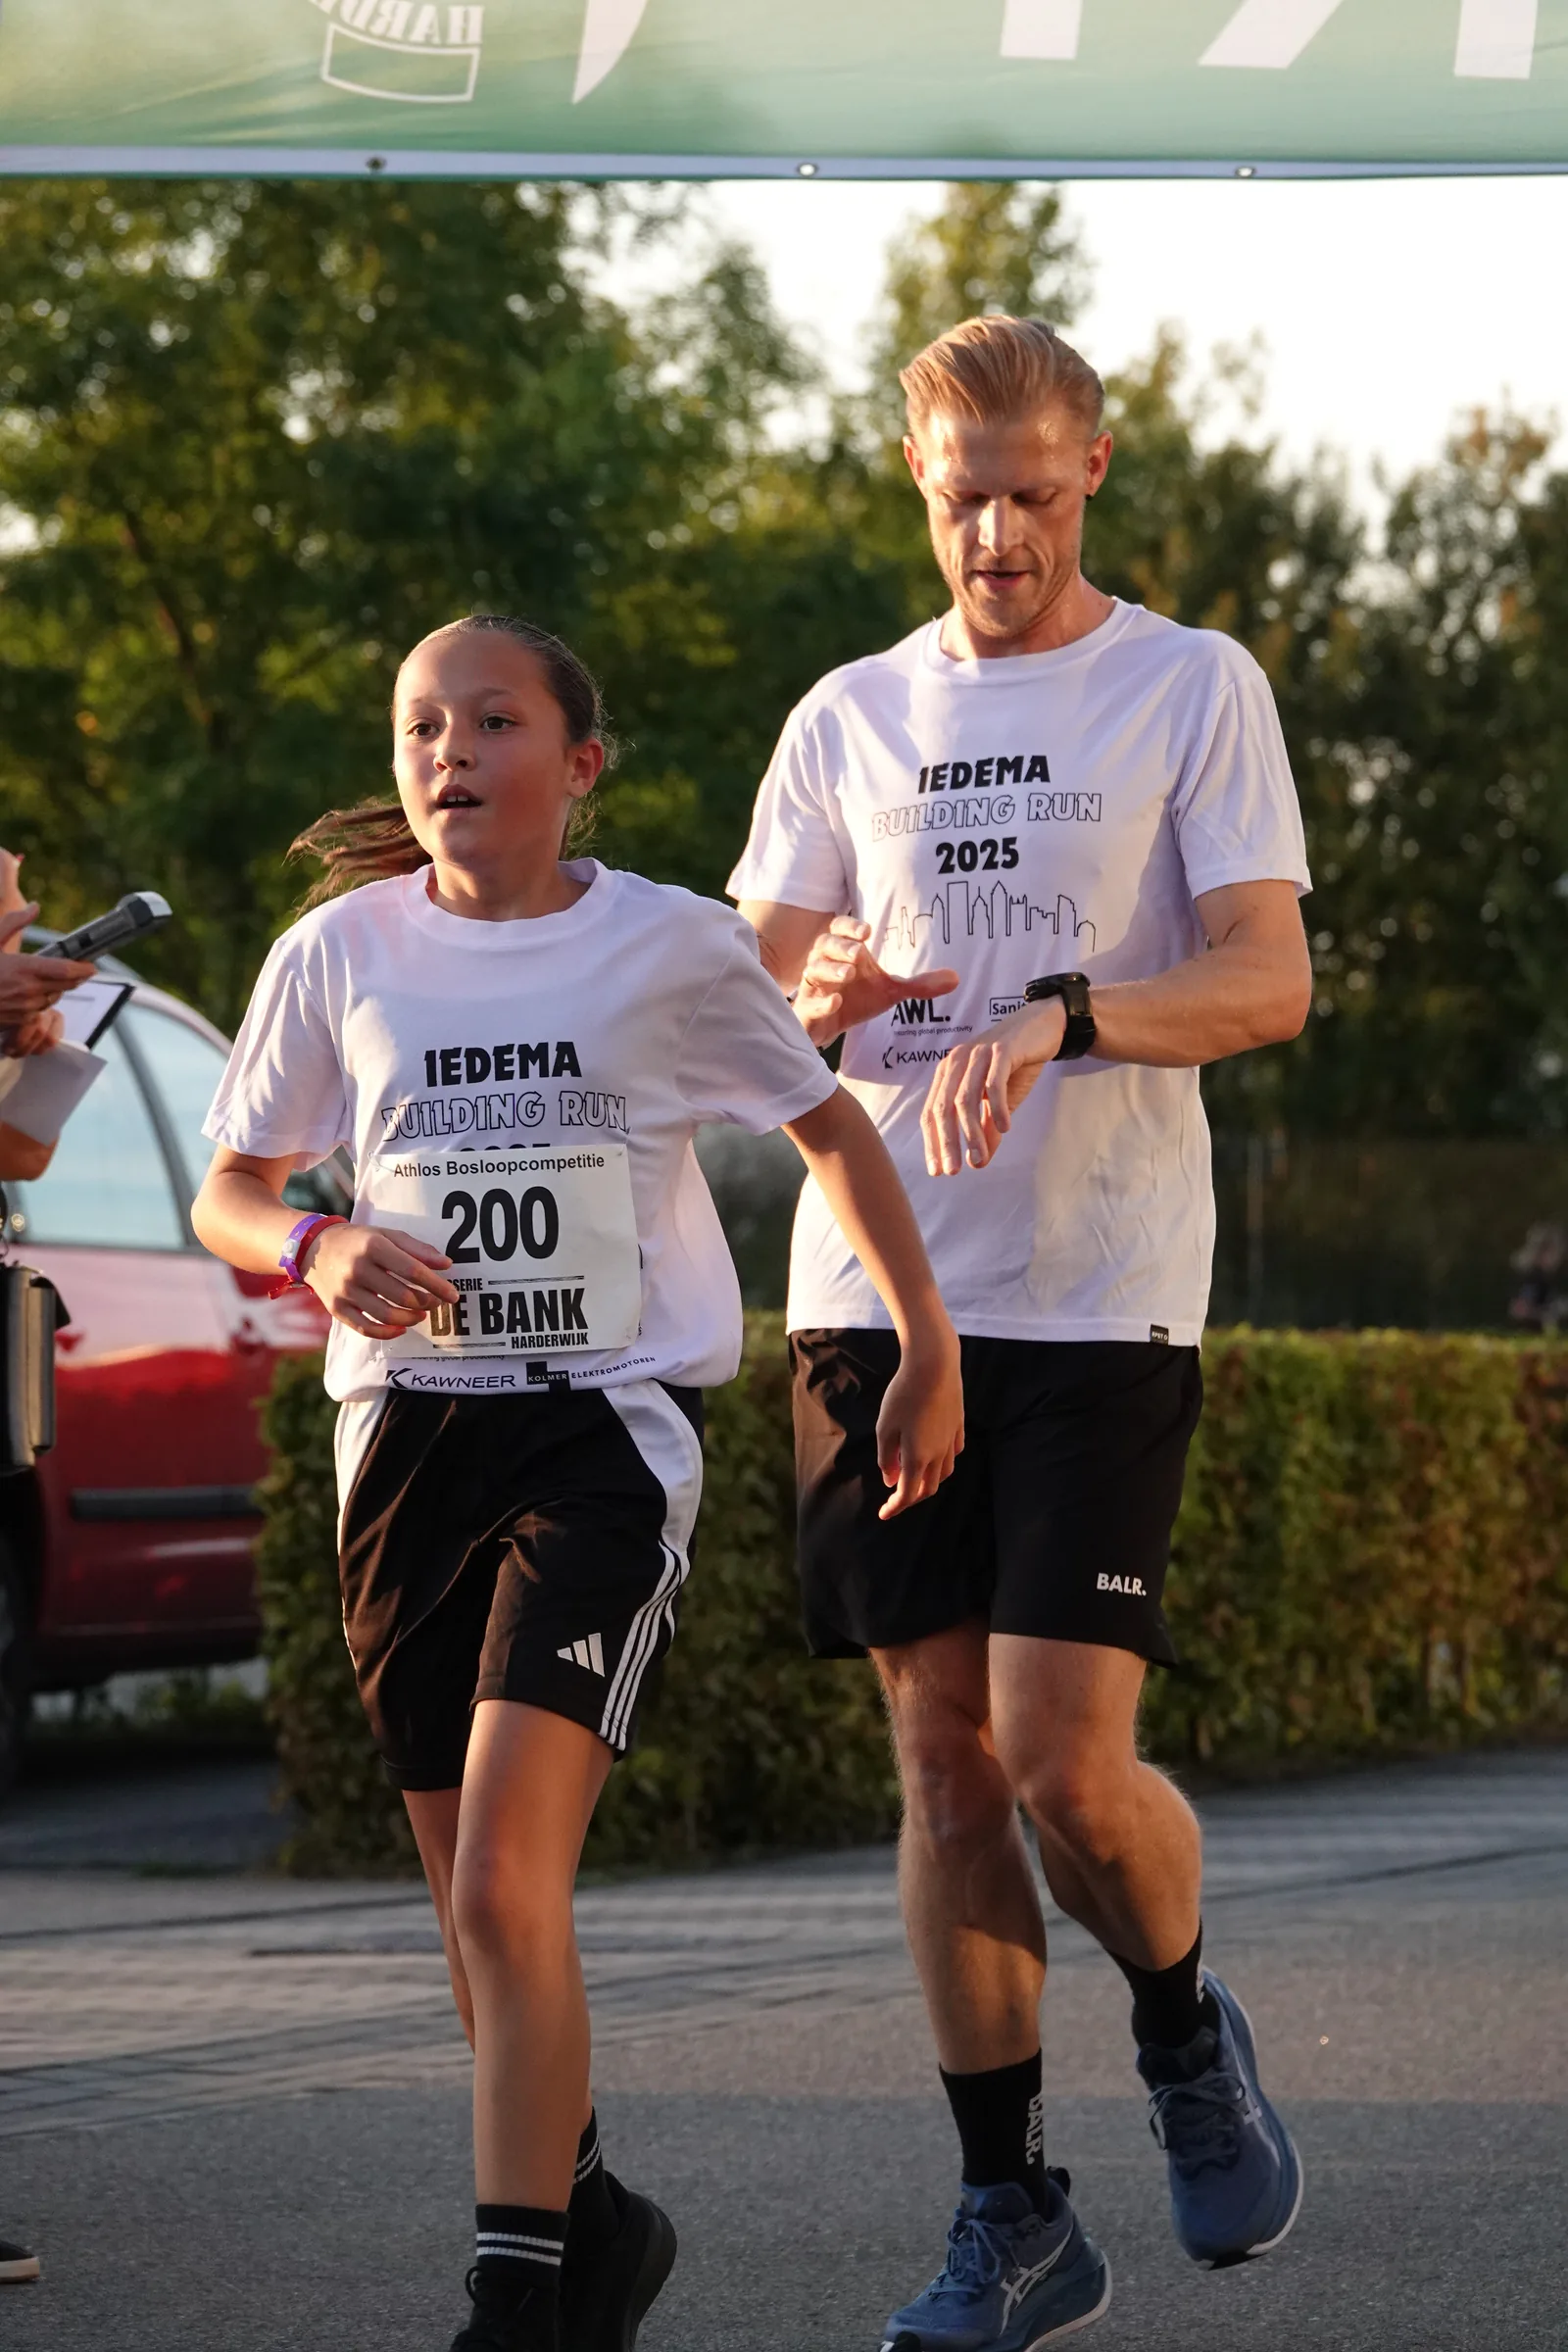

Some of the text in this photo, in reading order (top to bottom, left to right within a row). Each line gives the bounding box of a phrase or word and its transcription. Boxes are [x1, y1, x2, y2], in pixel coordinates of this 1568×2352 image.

[918, 755, 1051, 794] IEDEMA
[871, 793, 1102, 842] BUILDING RUN
[935, 836, 1019, 874] 2025
[917, 1027, 935, 1037] global
[936, 1025, 973, 1035] productivity
[423, 1041, 582, 1088] IEDEMA
[380, 1090, 627, 1142] BUILDING RUN
[394, 1153, 606, 1179] Athlos Bosloopcompetitie
[441, 1186, 560, 1264] 200
[429, 1288, 589, 1337] DE BANK
[511, 1332, 589, 1349] HARDERWIJK
[411, 1372, 516, 1390] KAWNEER
[527, 1356, 657, 1383] KOLMER ELEKTROMOTOREN
[1096, 1572, 1148, 1596] BALR.
